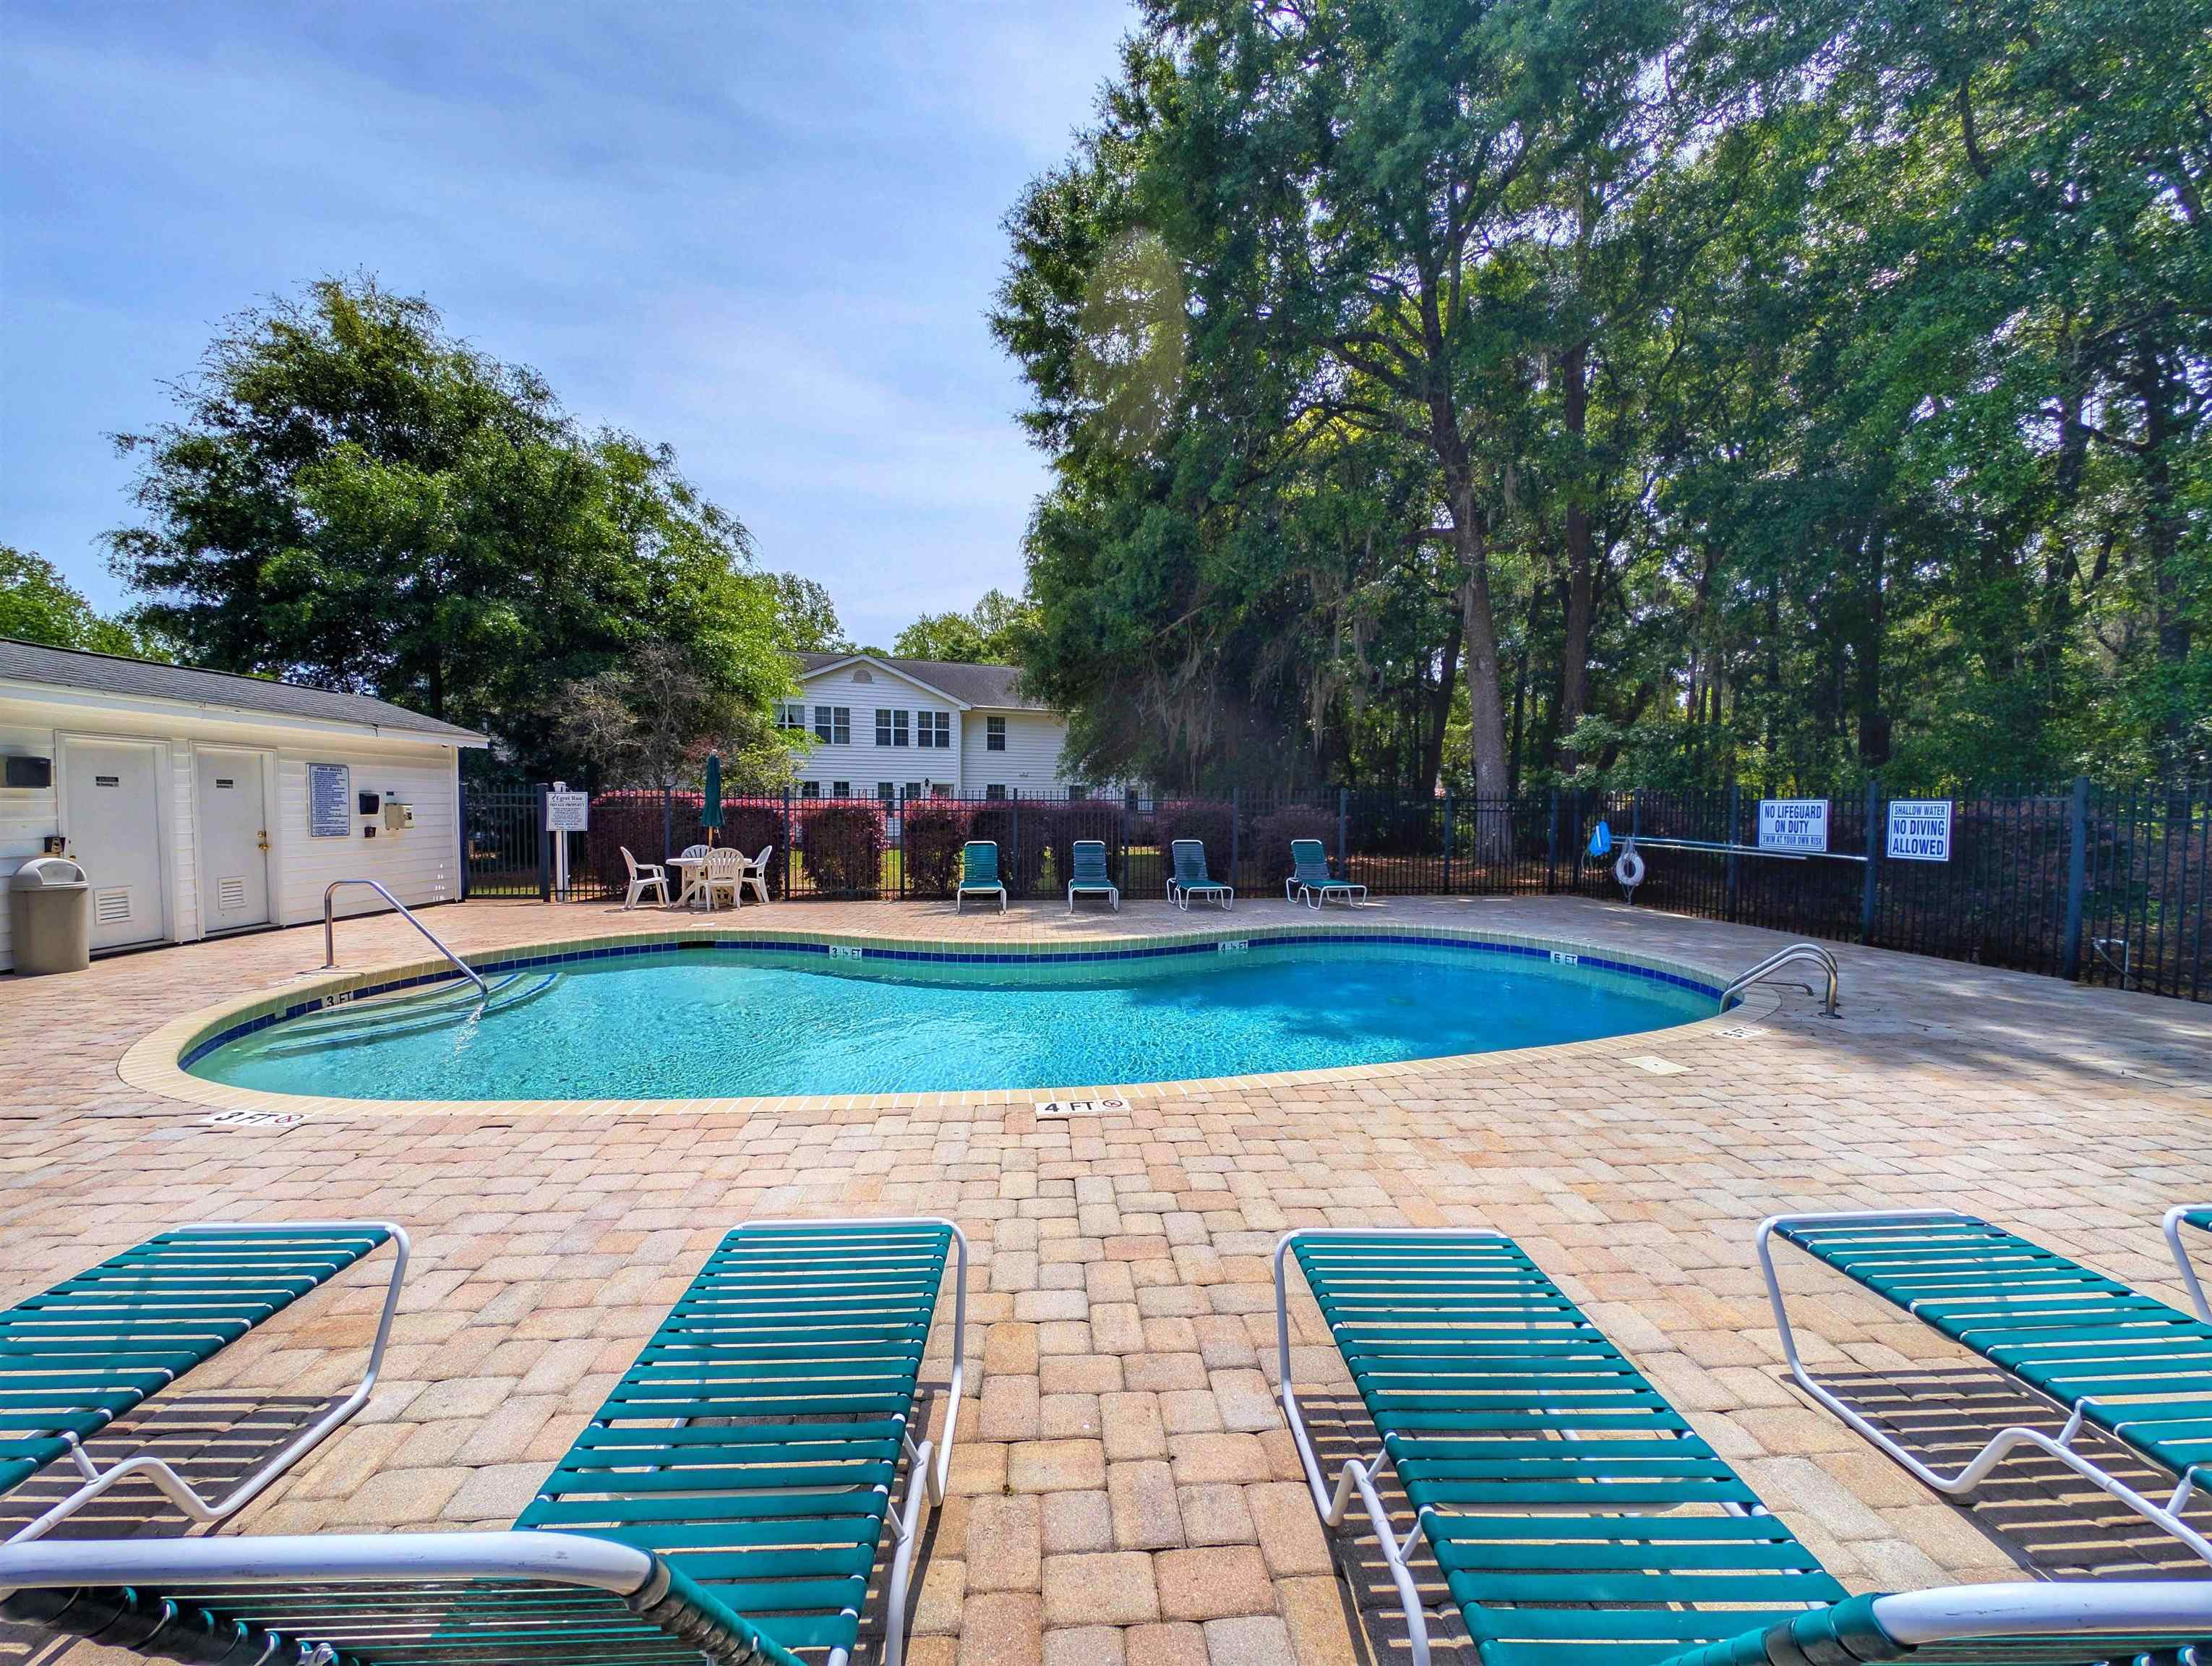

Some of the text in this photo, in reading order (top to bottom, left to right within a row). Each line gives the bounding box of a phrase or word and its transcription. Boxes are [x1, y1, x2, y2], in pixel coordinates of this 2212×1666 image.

[1765, 805, 1822, 819] NO LIFEGUARD
[1895, 806, 1945, 816] SHALLOW WATER
[1775, 820, 1809, 833] ON DUTY
[1894, 819, 1945, 836] NO DIVING
[1763, 835, 1822, 845] SWIM AT YOUR OWN RISK
[1892, 838, 1944, 855] ALLOWED
[327, 991, 351, 1007] 3 FT
[1045, 1101, 1094, 1112] 4 FT
[214, 1111, 279, 1124] 3 FT
